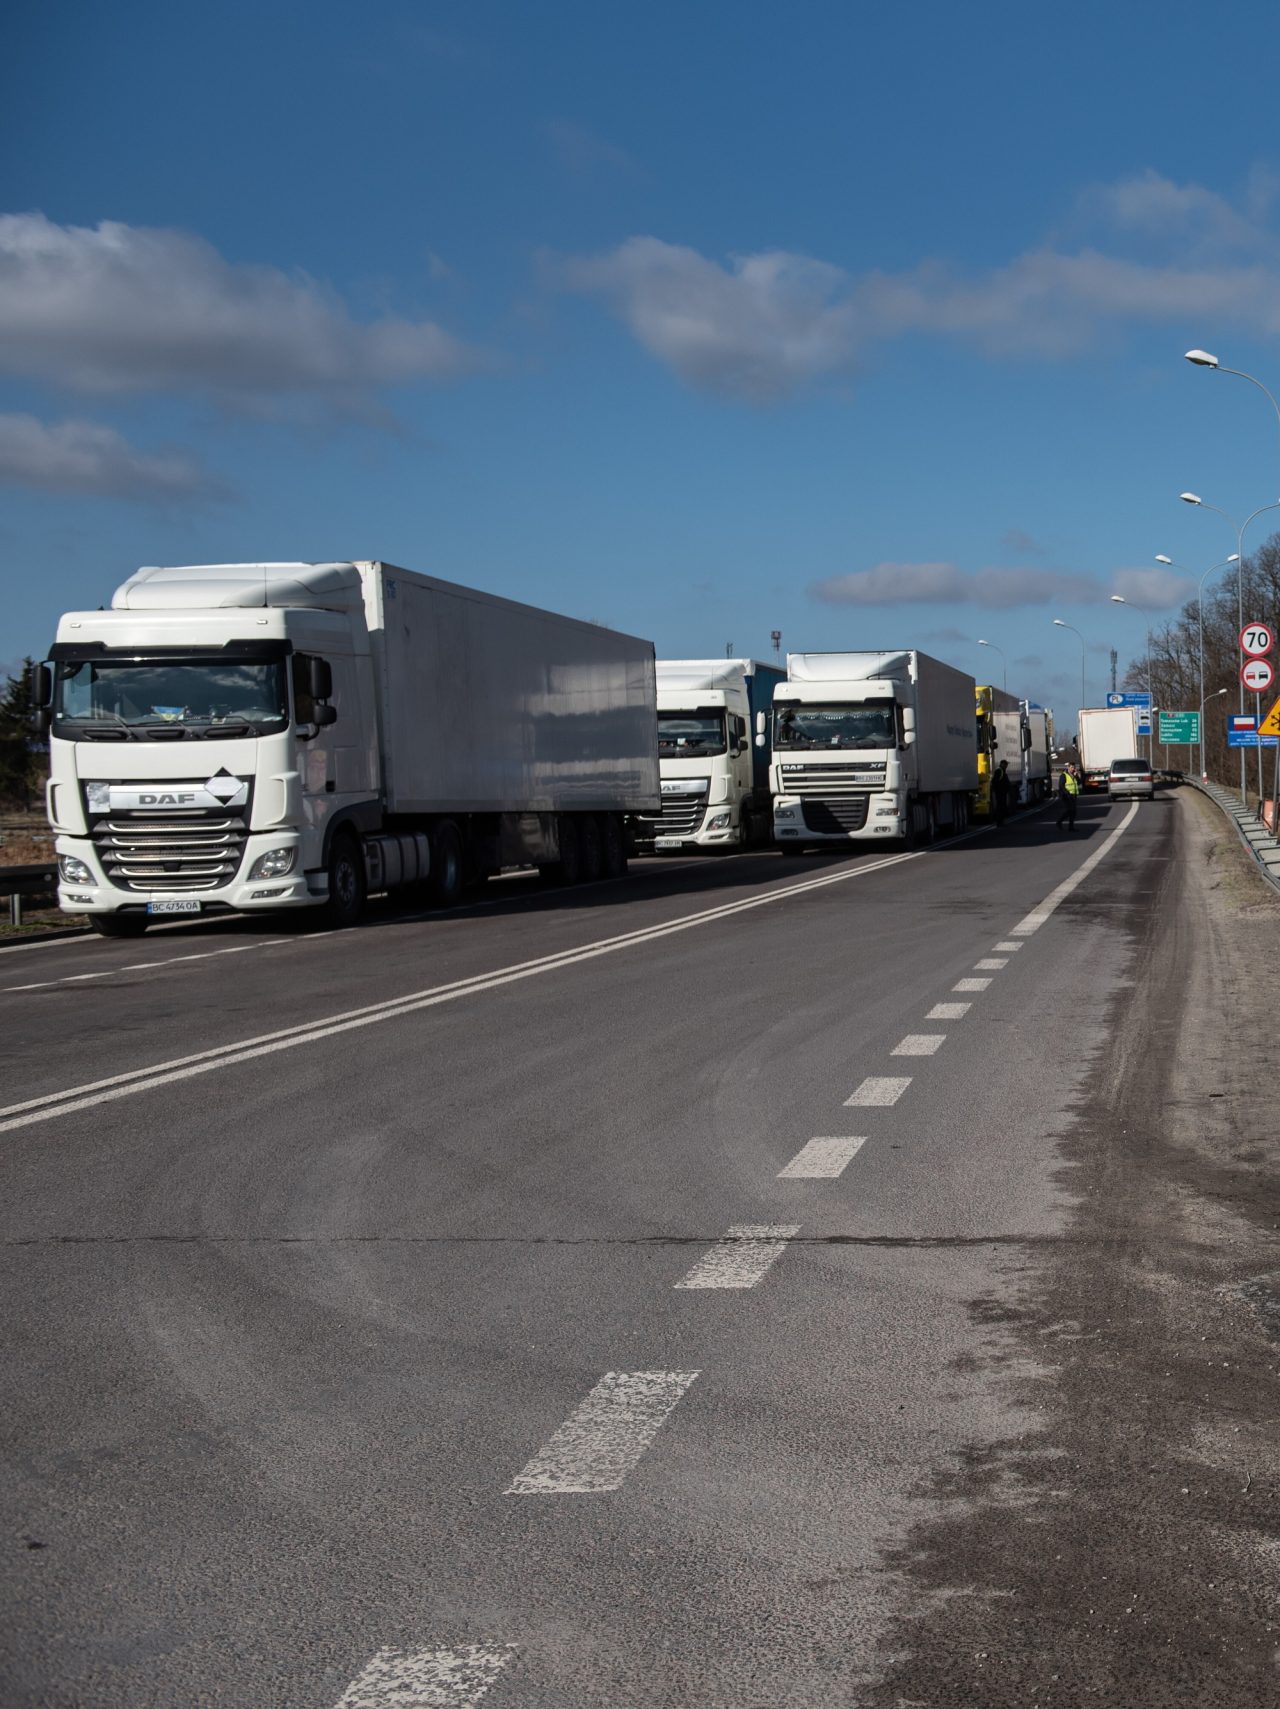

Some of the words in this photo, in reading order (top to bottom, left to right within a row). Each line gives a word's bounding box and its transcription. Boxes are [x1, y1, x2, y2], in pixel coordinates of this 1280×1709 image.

[1247, 632, 1268, 648] 70
[139, 793, 195, 804] DAF
[152, 903, 164, 911] BC
[165, 902, 185, 911] 4734
